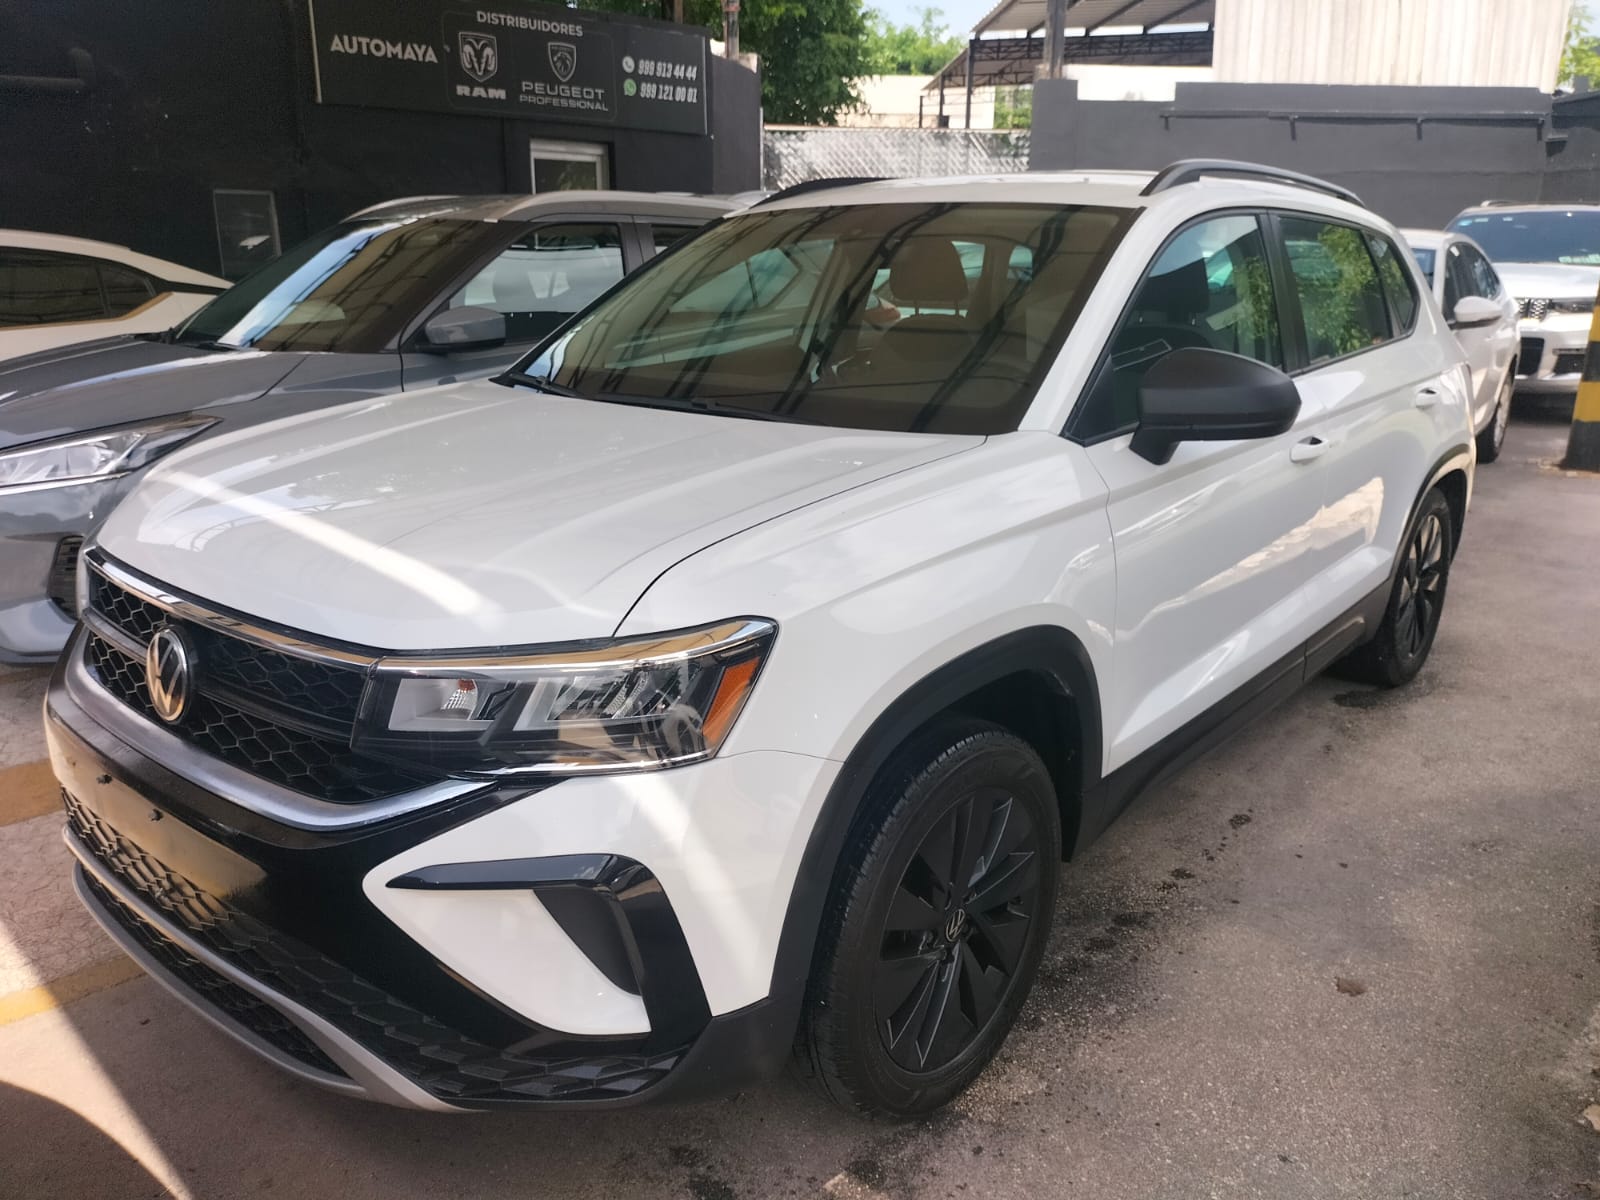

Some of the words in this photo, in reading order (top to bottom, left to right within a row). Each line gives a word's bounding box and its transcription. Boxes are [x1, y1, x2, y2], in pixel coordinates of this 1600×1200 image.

[476, 11, 584, 37] DISTRIBUIDORES
[330, 34, 438, 63] AUTOMAYA
[638, 59, 655, 76] 999
[656, 61, 673, 78] 913
[674, 64, 685, 80] 44
[686, 65, 697, 81] 44
[456, 84, 507, 100] RAM
[521, 81, 605, 100] PEUGEOT
[640, 82, 657, 99] 999
[657, 84, 673, 101] 121
[675, 86, 686, 102] 00
[519, 95, 609, 112] PROFESSIONAL
